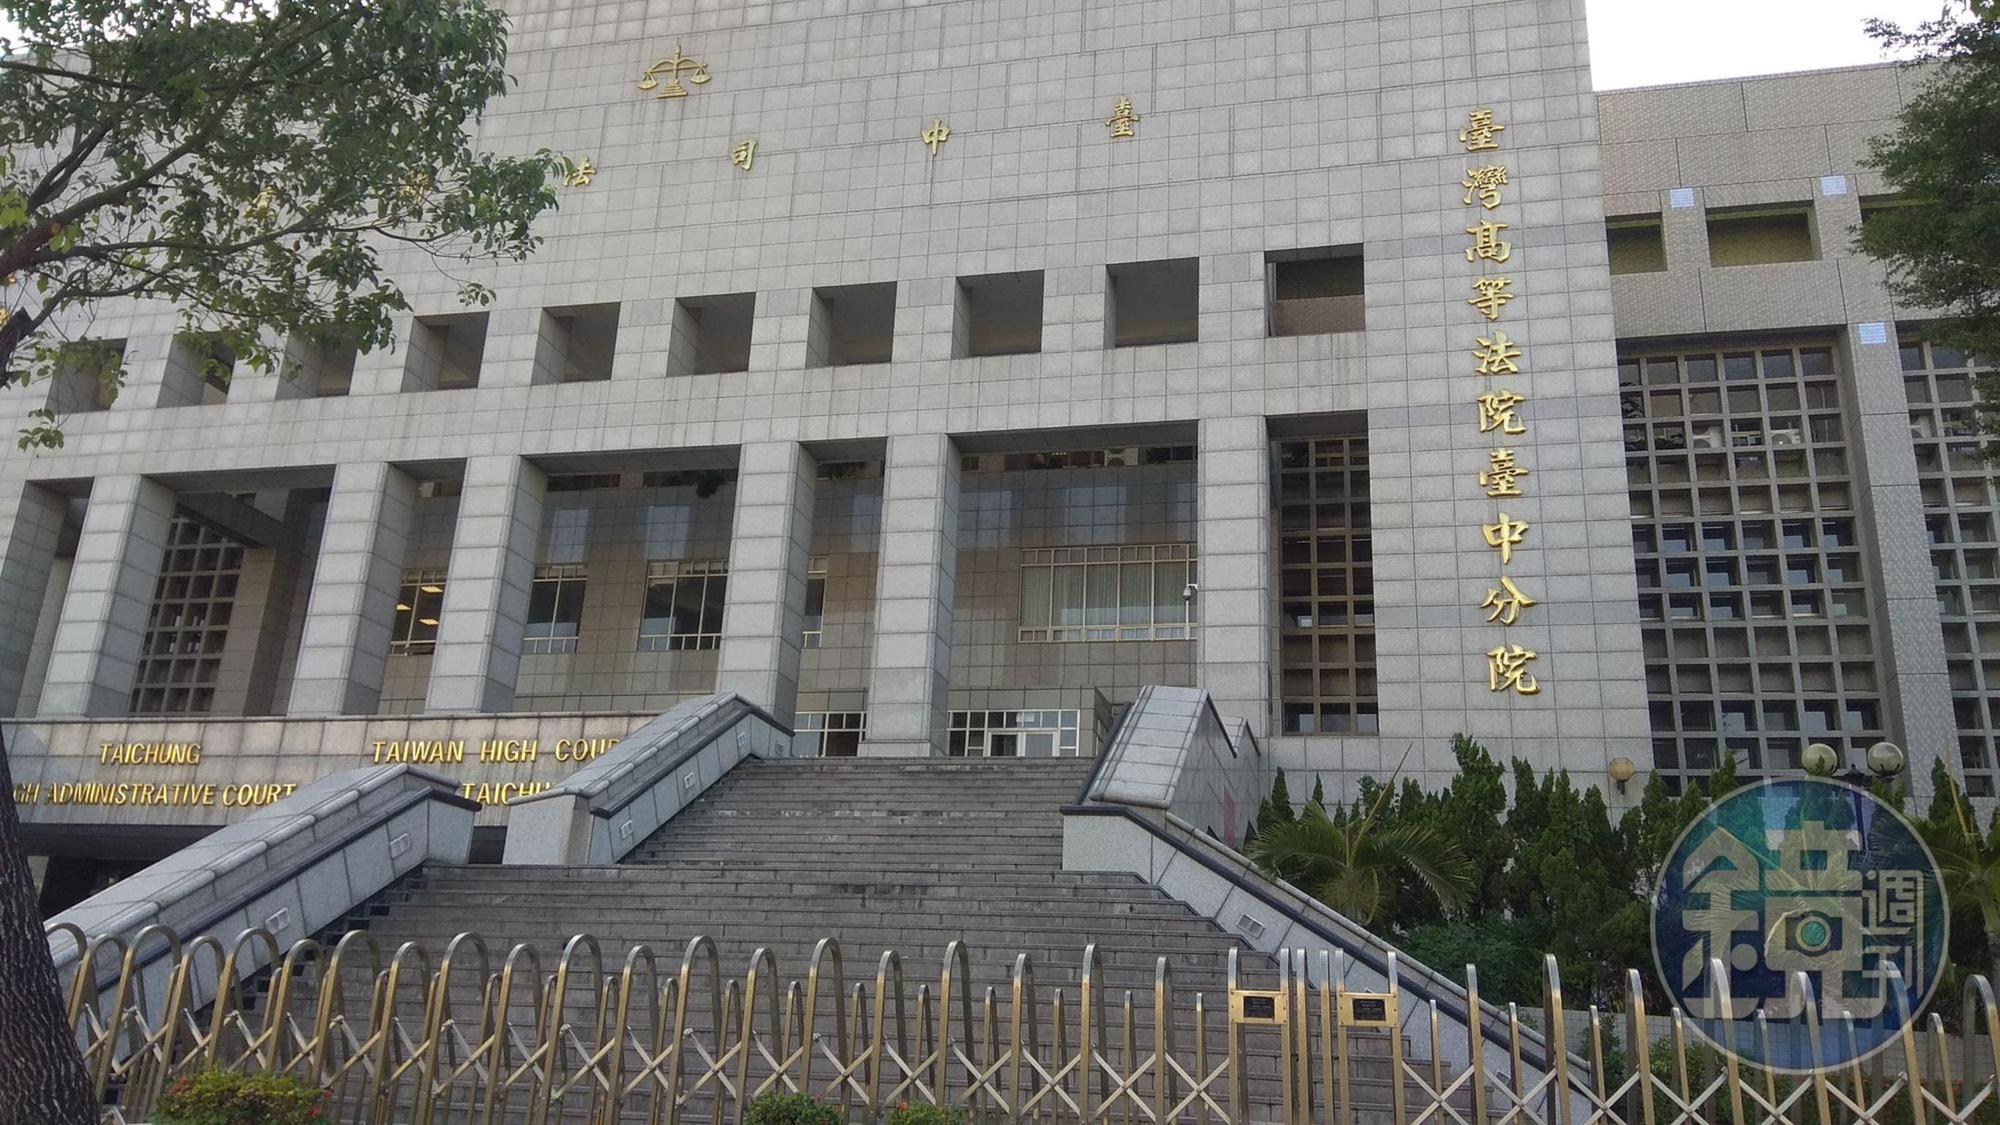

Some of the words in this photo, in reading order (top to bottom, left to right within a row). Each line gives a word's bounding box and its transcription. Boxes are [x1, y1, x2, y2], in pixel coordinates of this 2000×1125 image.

[100, 743, 201, 765] TAICHUNG
[373, 740, 465, 763] TAIWAN
[480, 739, 538, 763] HIGH
[555, 738, 620, 761] COU
[45, 782, 216, 806] ADMINISTRATIVE
[222, 783, 297, 807] COURT
[462, 782, 551, 805] TAICH
